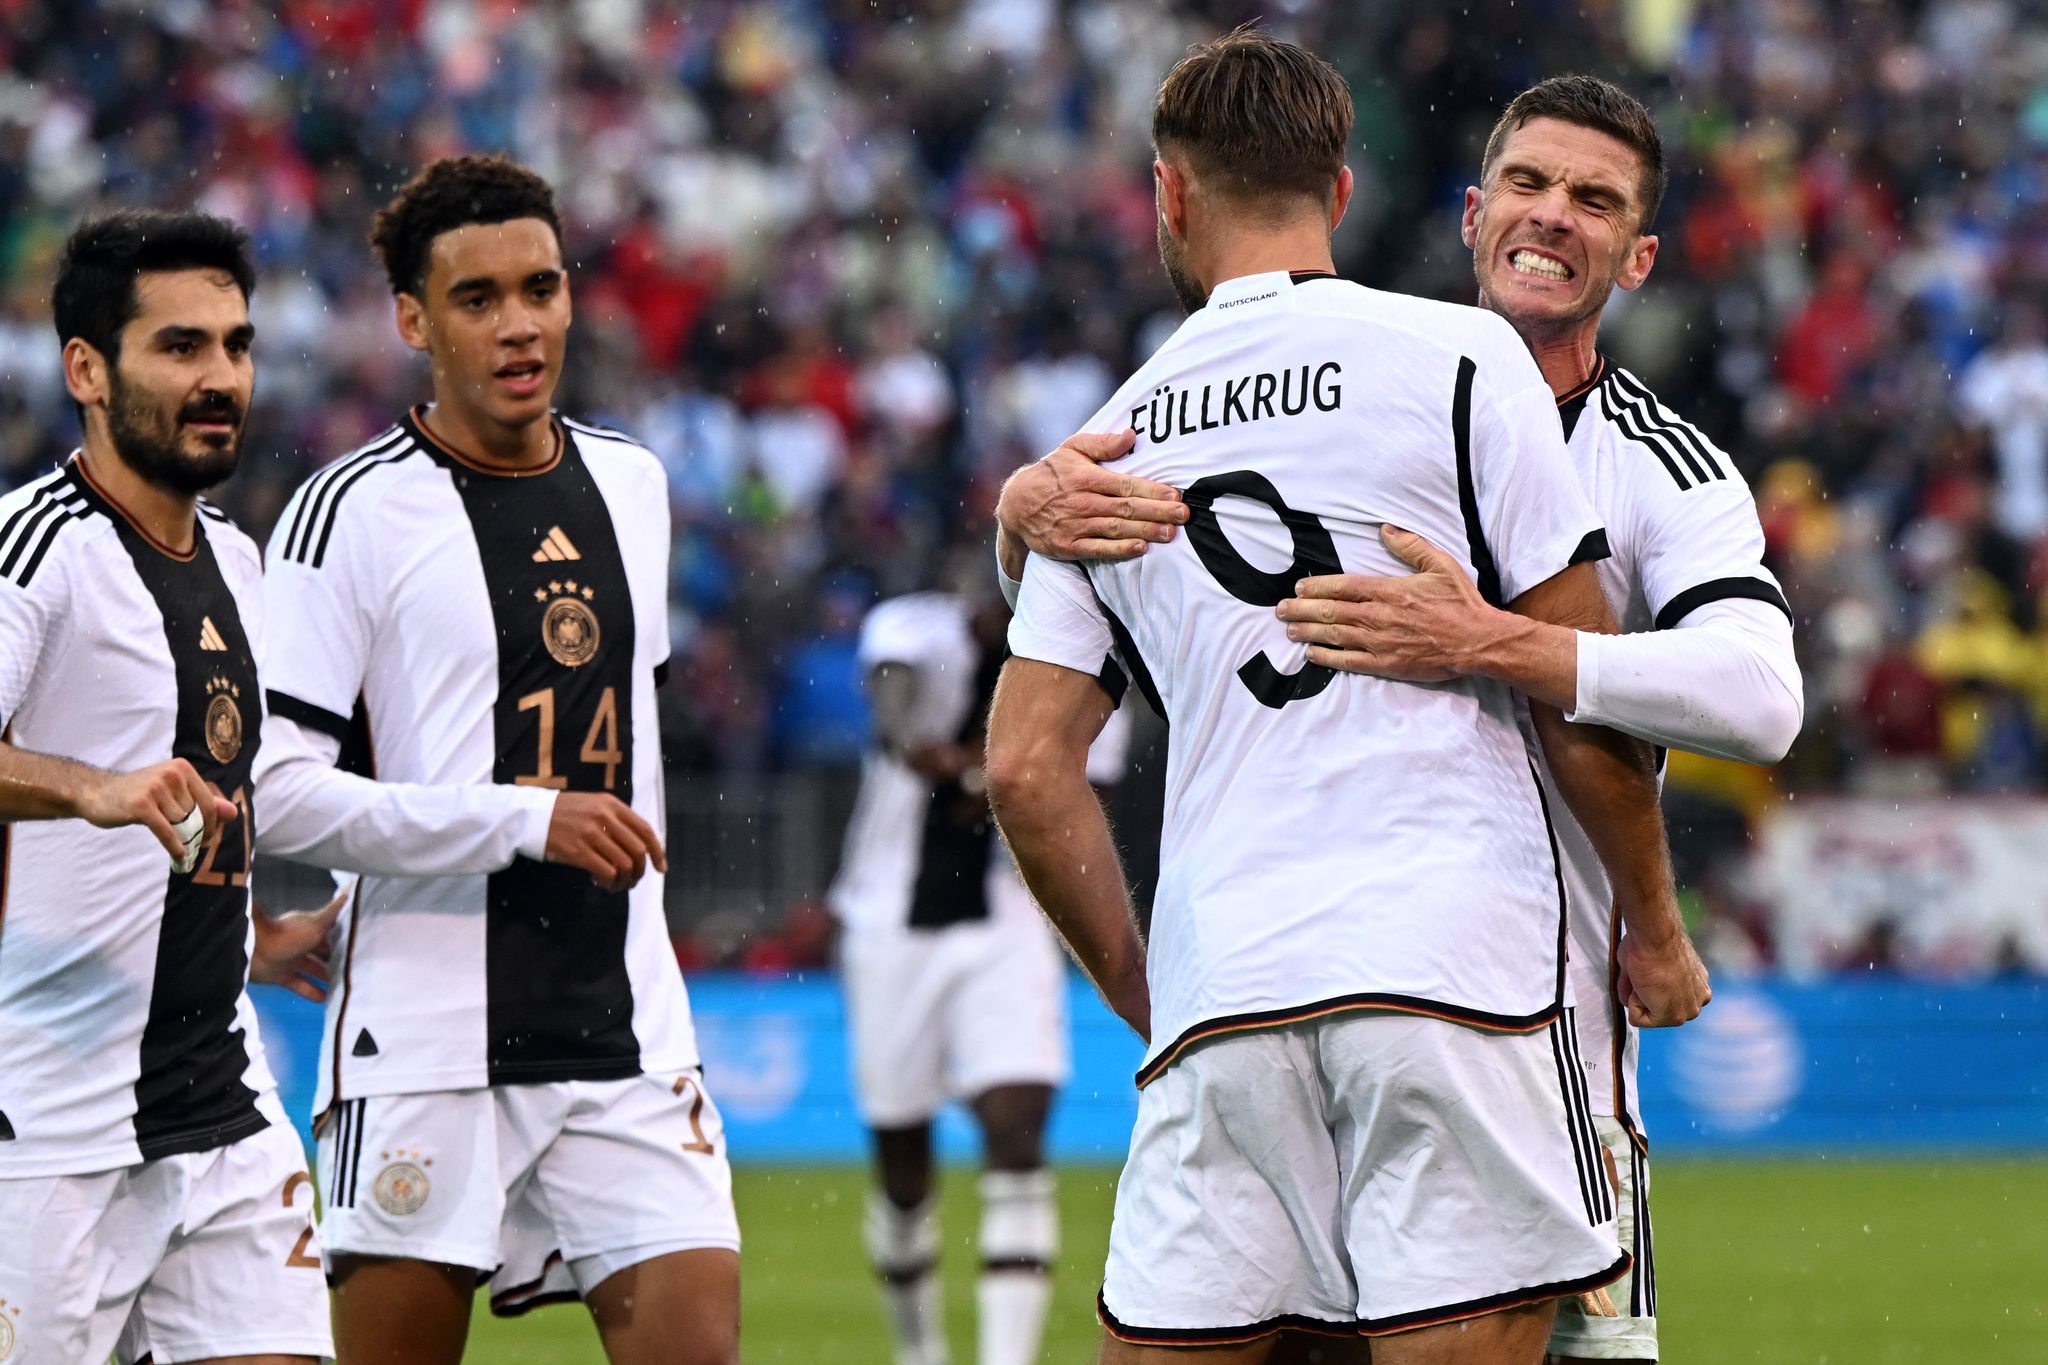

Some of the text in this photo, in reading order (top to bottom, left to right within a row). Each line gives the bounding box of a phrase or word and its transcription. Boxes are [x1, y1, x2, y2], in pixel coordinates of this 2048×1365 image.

[1218, 291, 1278, 310] DEUTSCHLAND
[1128, 361, 1342, 455] FÜLLKRUG
[1182, 469, 1345, 709] 9
[514, 686, 623, 790] 14
